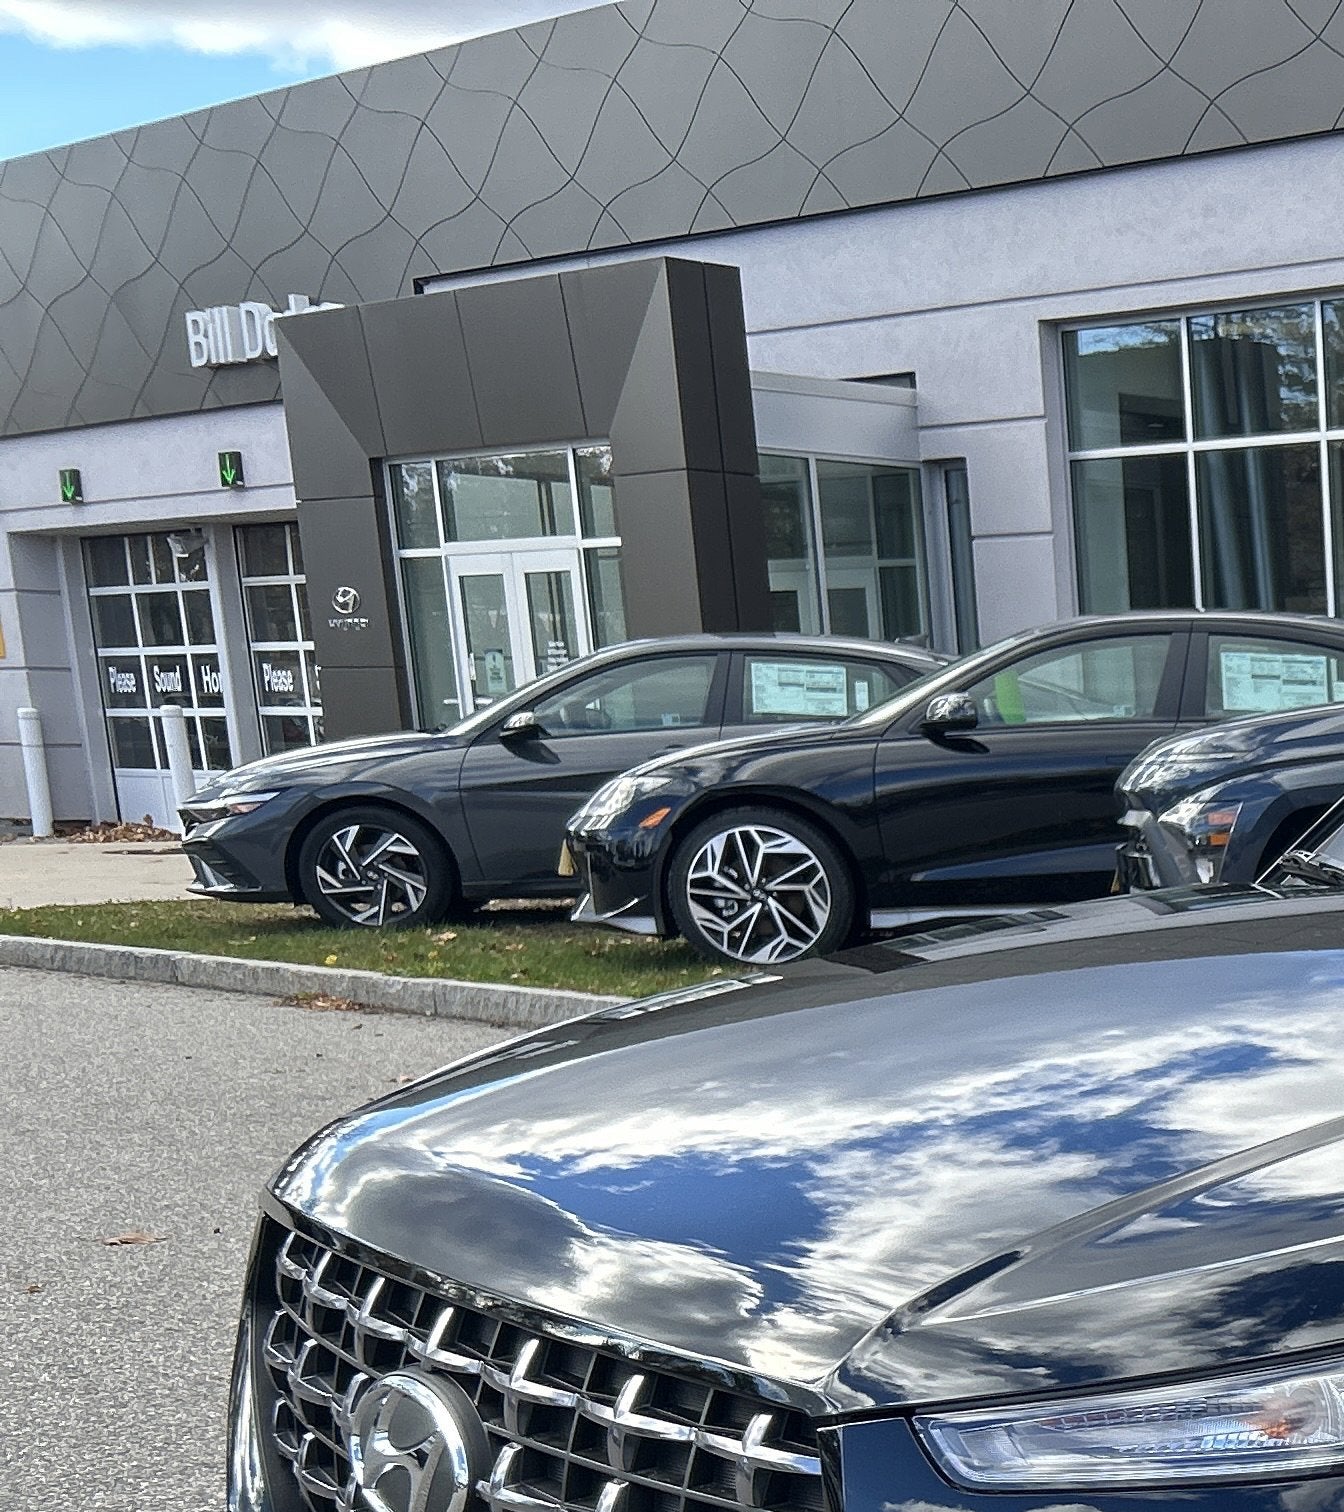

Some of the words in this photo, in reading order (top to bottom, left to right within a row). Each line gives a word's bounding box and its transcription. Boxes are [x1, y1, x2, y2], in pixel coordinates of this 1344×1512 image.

[185, 307, 233, 368] Bill
[108, 666, 136, 693] Please
[153, 665, 182, 692] Sound
[262, 663, 294, 692] Please
